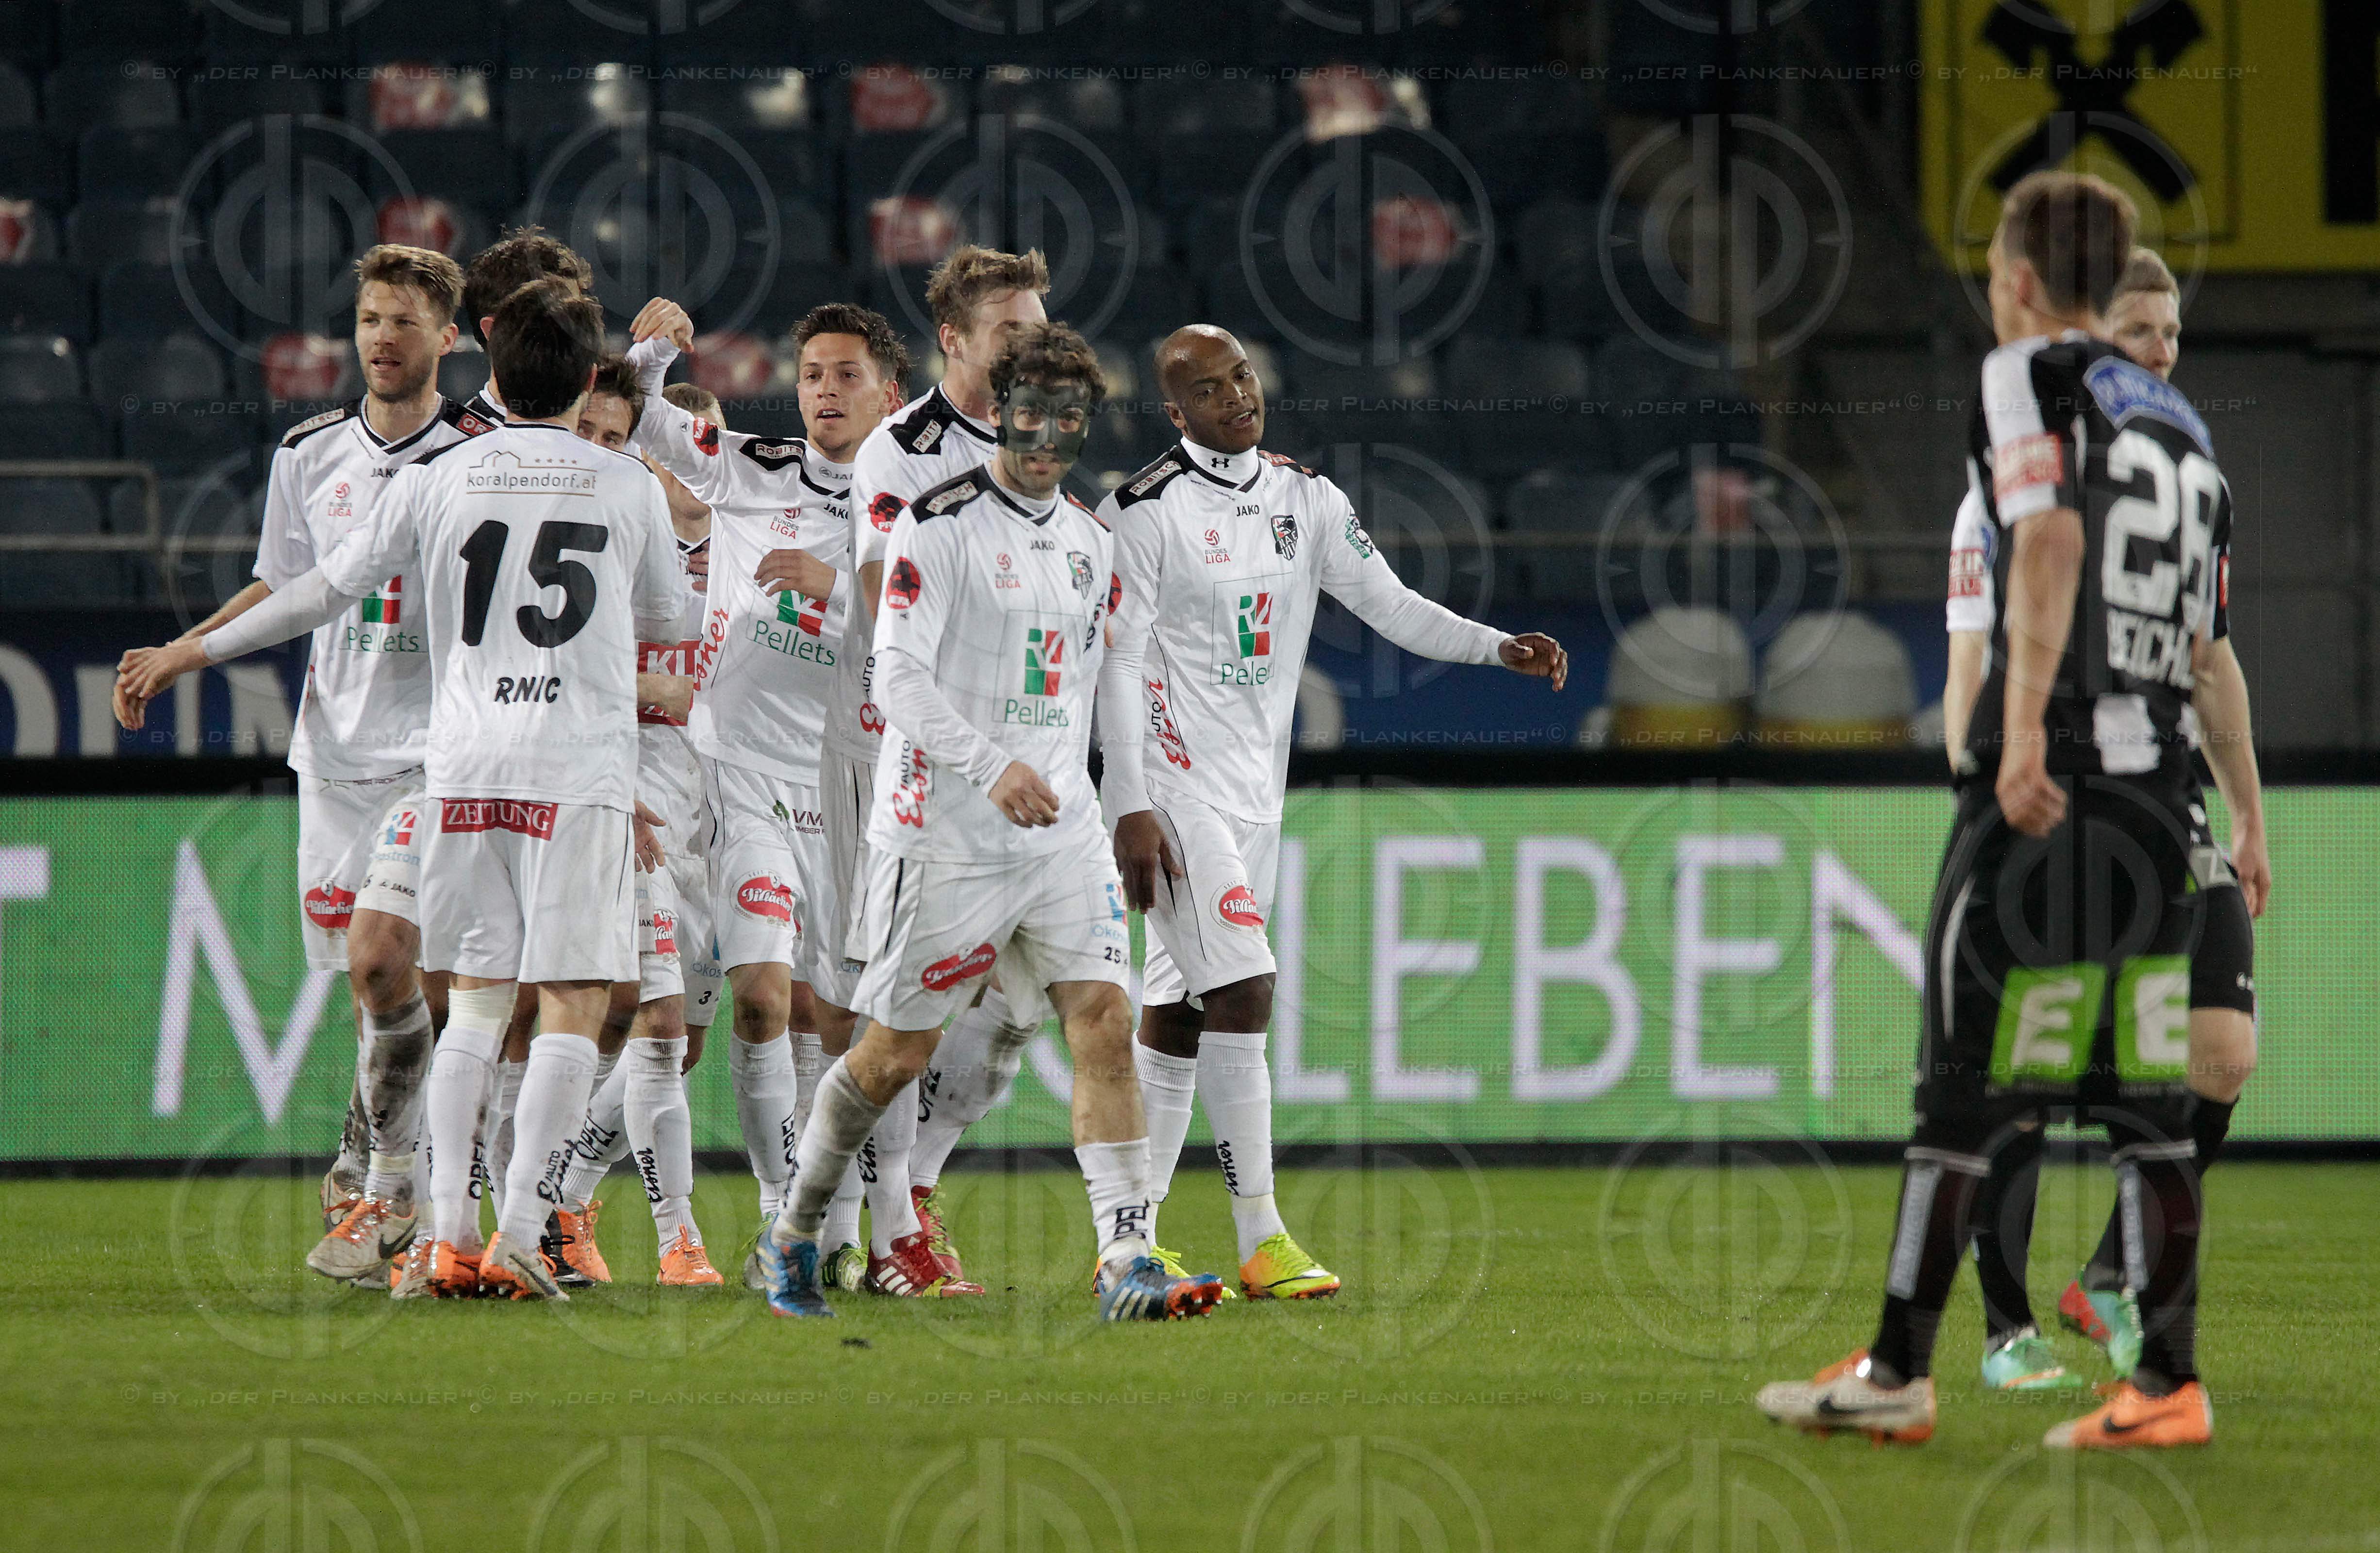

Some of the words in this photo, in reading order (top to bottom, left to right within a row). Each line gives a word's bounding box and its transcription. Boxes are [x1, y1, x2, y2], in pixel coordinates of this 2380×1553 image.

[467, 472, 597, 490] koralpendorf.at
[1236, 504, 1260, 517] JAKO
[769, 521, 797, 540] LIGA
[773, 515, 800, 531] BUNDES
[1029, 540, 1055, 551] JAKO
[1205, 554, 1231, 564] LIGA
[460, 520, 608, 648] 15
[995, 580, 1021, 589] LIGA
[347, 627, 420, 652] Pellets
[752, 619, 836, 666] Pellets
[495, 676, 562, 705] RNIC
[1151, 701, 1161, 732] UTO
[900, 740, 911, 786] AUTO
[444, 801, 551, 832] ZEITUNG
[1104, 946, 1121, 964] 25
[576, 1114, 620, 1161] OPEL
